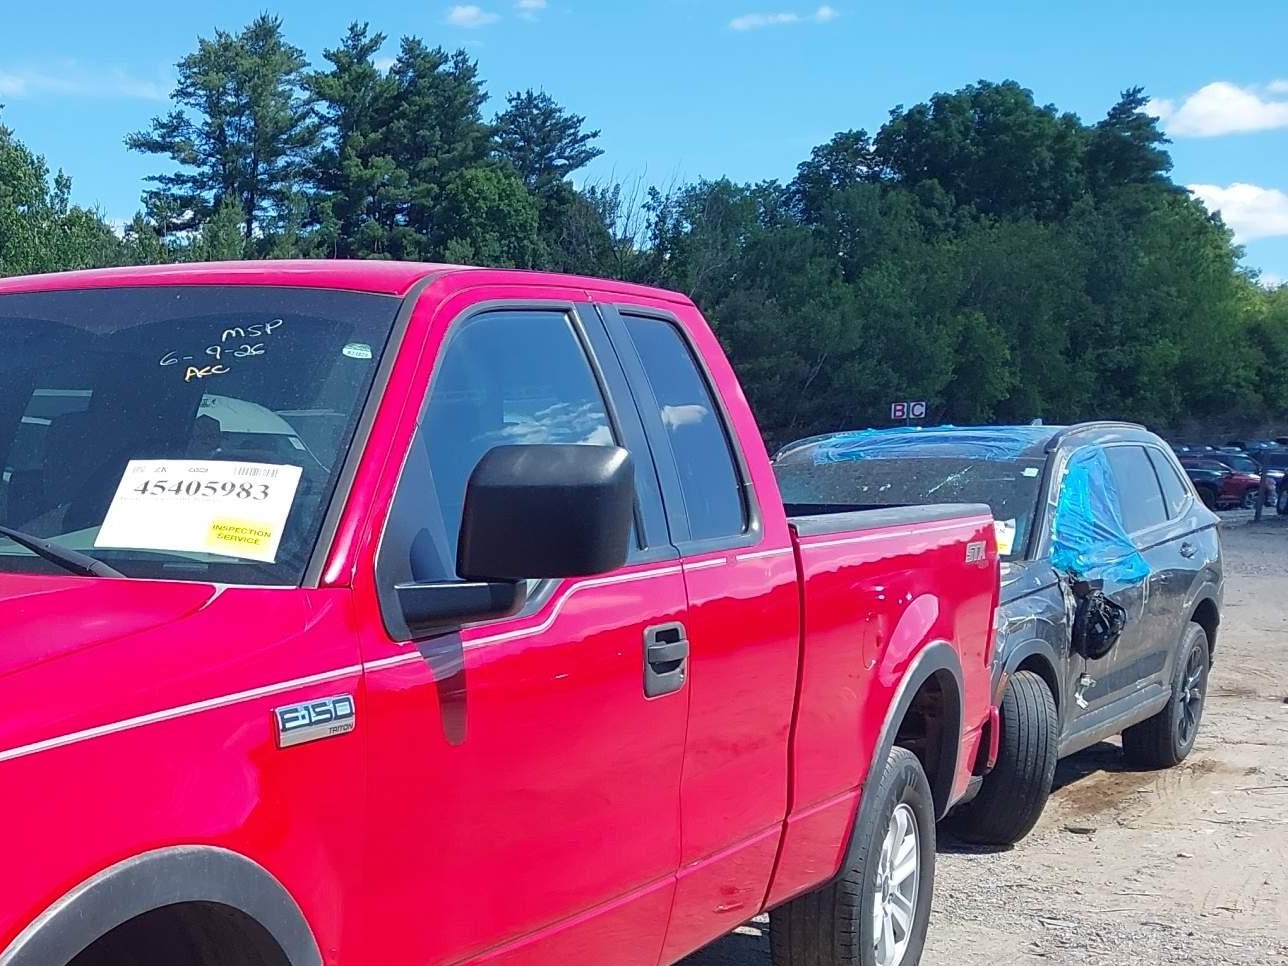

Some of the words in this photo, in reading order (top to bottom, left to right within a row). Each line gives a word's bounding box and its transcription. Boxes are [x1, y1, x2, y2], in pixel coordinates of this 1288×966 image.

[221, 318, 284, 342] MSP
[184, 365, 231, 383] ACC
[893, 403, 906, 418] B
[911, 402, 925, 417] C
[133, 479, 271, 501] 45405983
[212, 523, 272, 539] INSPECTION
[216, 533, 261, 546] SERVICE
[278, 696, 355, 732] F-150
[327, 722, 354, 735] TRITON
